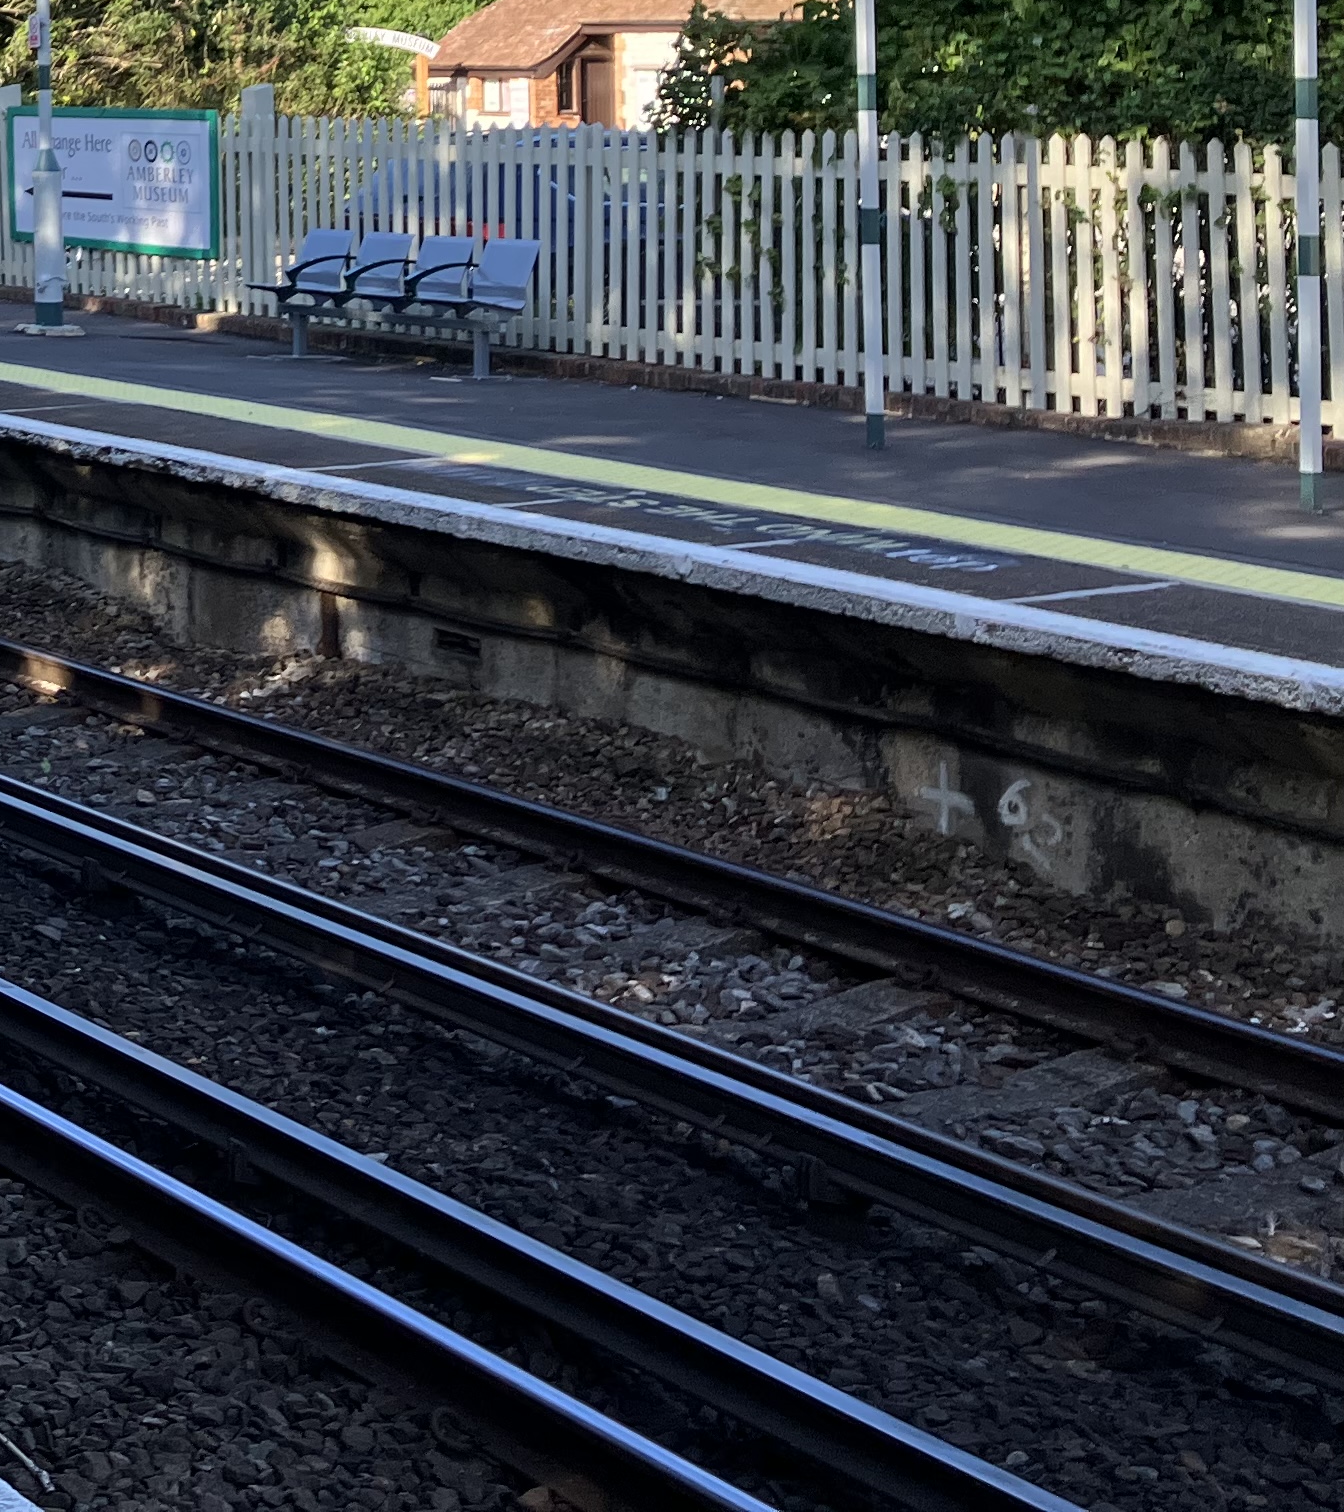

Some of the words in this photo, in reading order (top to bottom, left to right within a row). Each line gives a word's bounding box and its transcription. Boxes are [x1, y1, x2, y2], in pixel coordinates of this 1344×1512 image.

[392, 32, 434, 54] MUSEUM
[22, 131, 37, 149] All
[51, 136, 81, 157] ange
[84, 134, 112, 152] Here
[126, 165, 194, 185] AMBERLEY
[132, 185, 189, 204] MUSEUM
[73, 211, 86, 222] the
[87, 212, 115, 224] South's
